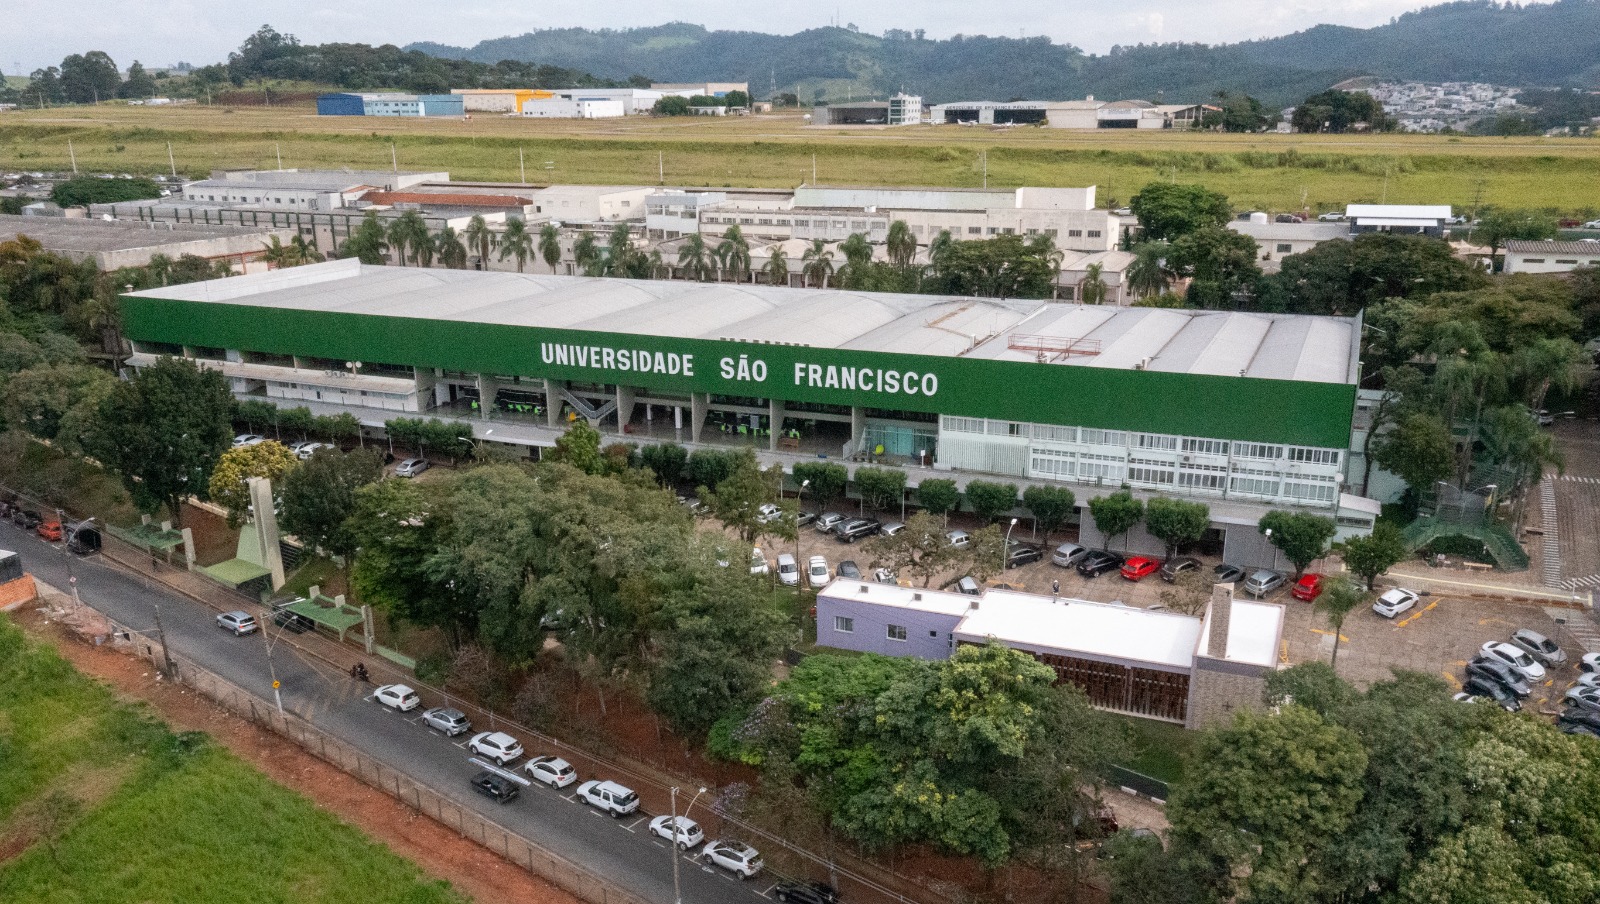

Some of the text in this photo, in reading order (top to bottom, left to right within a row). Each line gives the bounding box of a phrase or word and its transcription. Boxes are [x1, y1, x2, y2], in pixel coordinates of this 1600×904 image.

[541, 342, 938, 396] UNIVERSIDADE SÃO FRANCISCO
